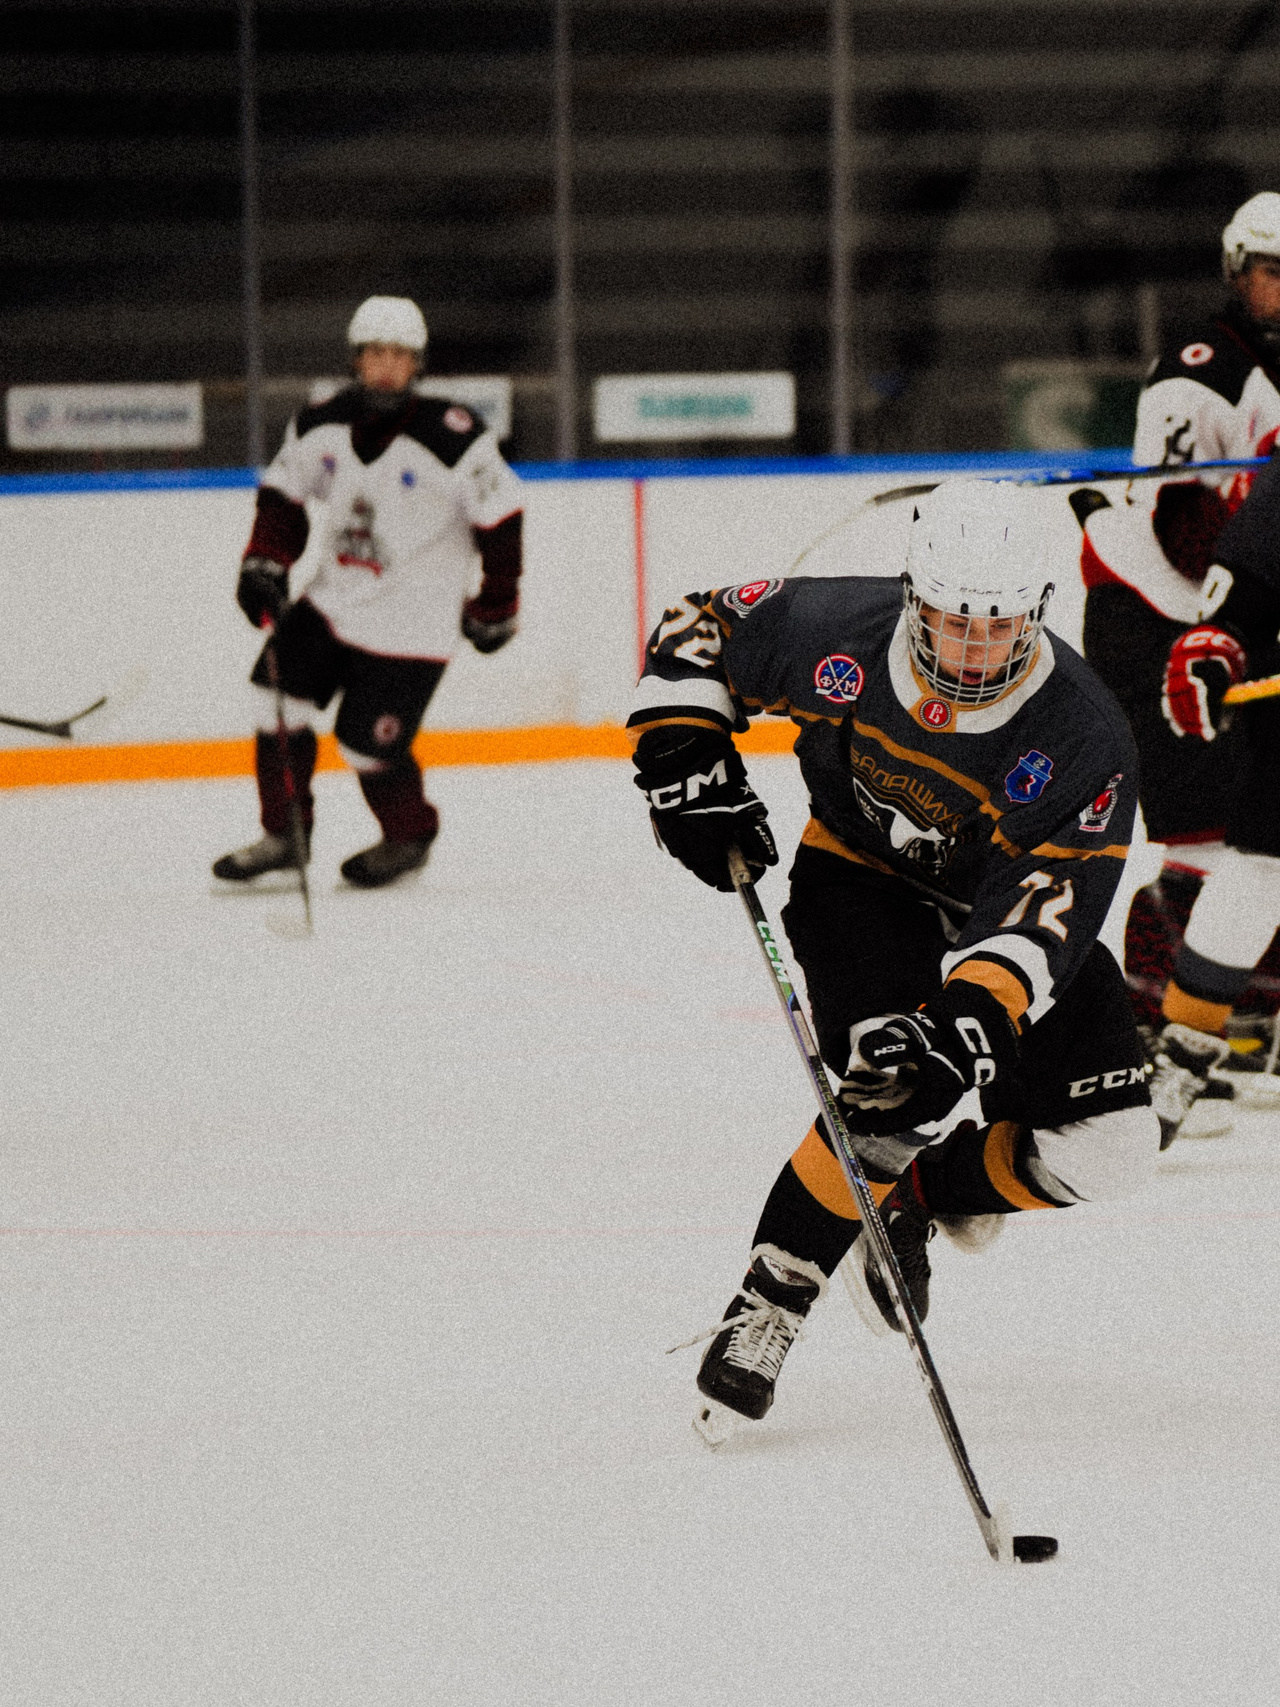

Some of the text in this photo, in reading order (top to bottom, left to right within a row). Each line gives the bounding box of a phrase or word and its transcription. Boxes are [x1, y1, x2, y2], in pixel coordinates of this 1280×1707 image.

[650, 596, 722, 669] 72
[1182, 630, 1243, 658] CC
[820, 675, 857, 693] ФХМ
[642, 759, 729, 810] CM
[998, 870, 1074, 943] 72
[1067, 1066, 1146, 1099] CCM
